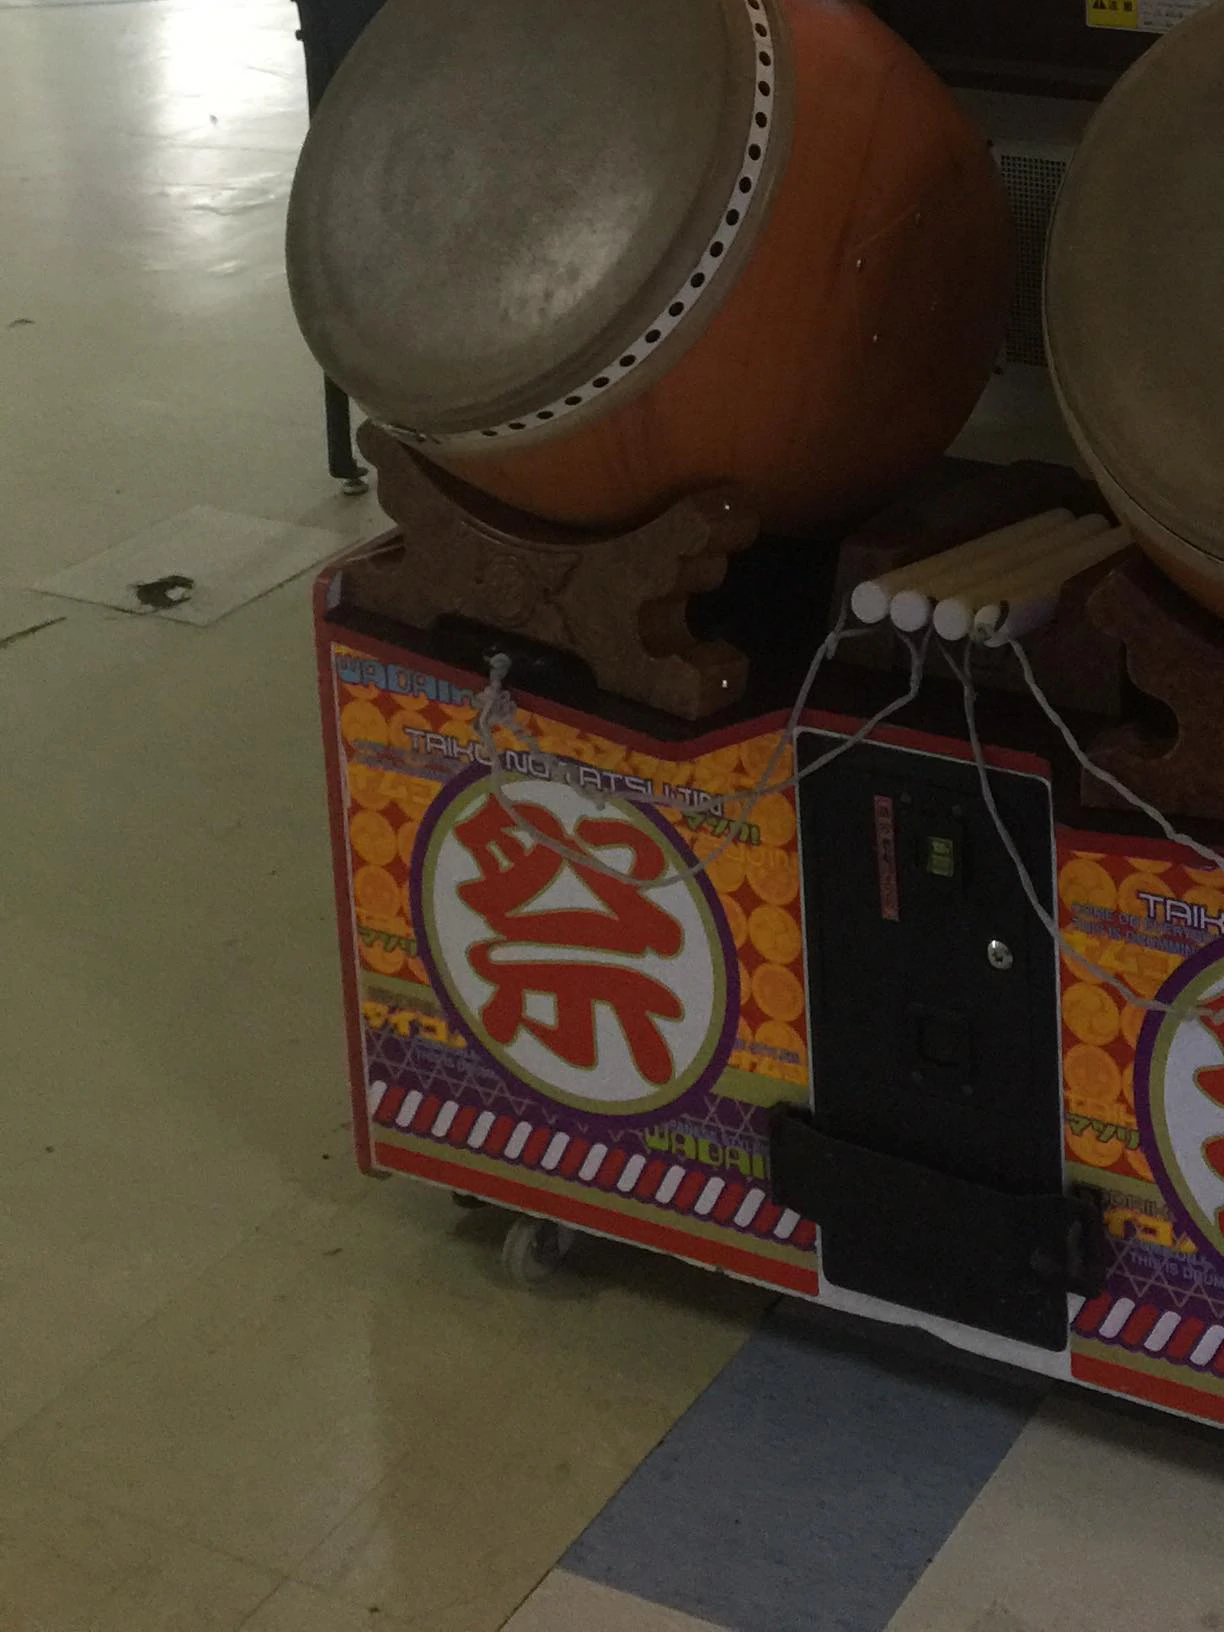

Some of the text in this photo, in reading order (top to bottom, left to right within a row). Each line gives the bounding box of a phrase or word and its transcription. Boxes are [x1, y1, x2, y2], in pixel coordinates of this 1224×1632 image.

[336, 654, 480, 708] WADAIK
[455, 791, 685, 1085] 祭
[644, 1123, 770, 1181] WADAI
